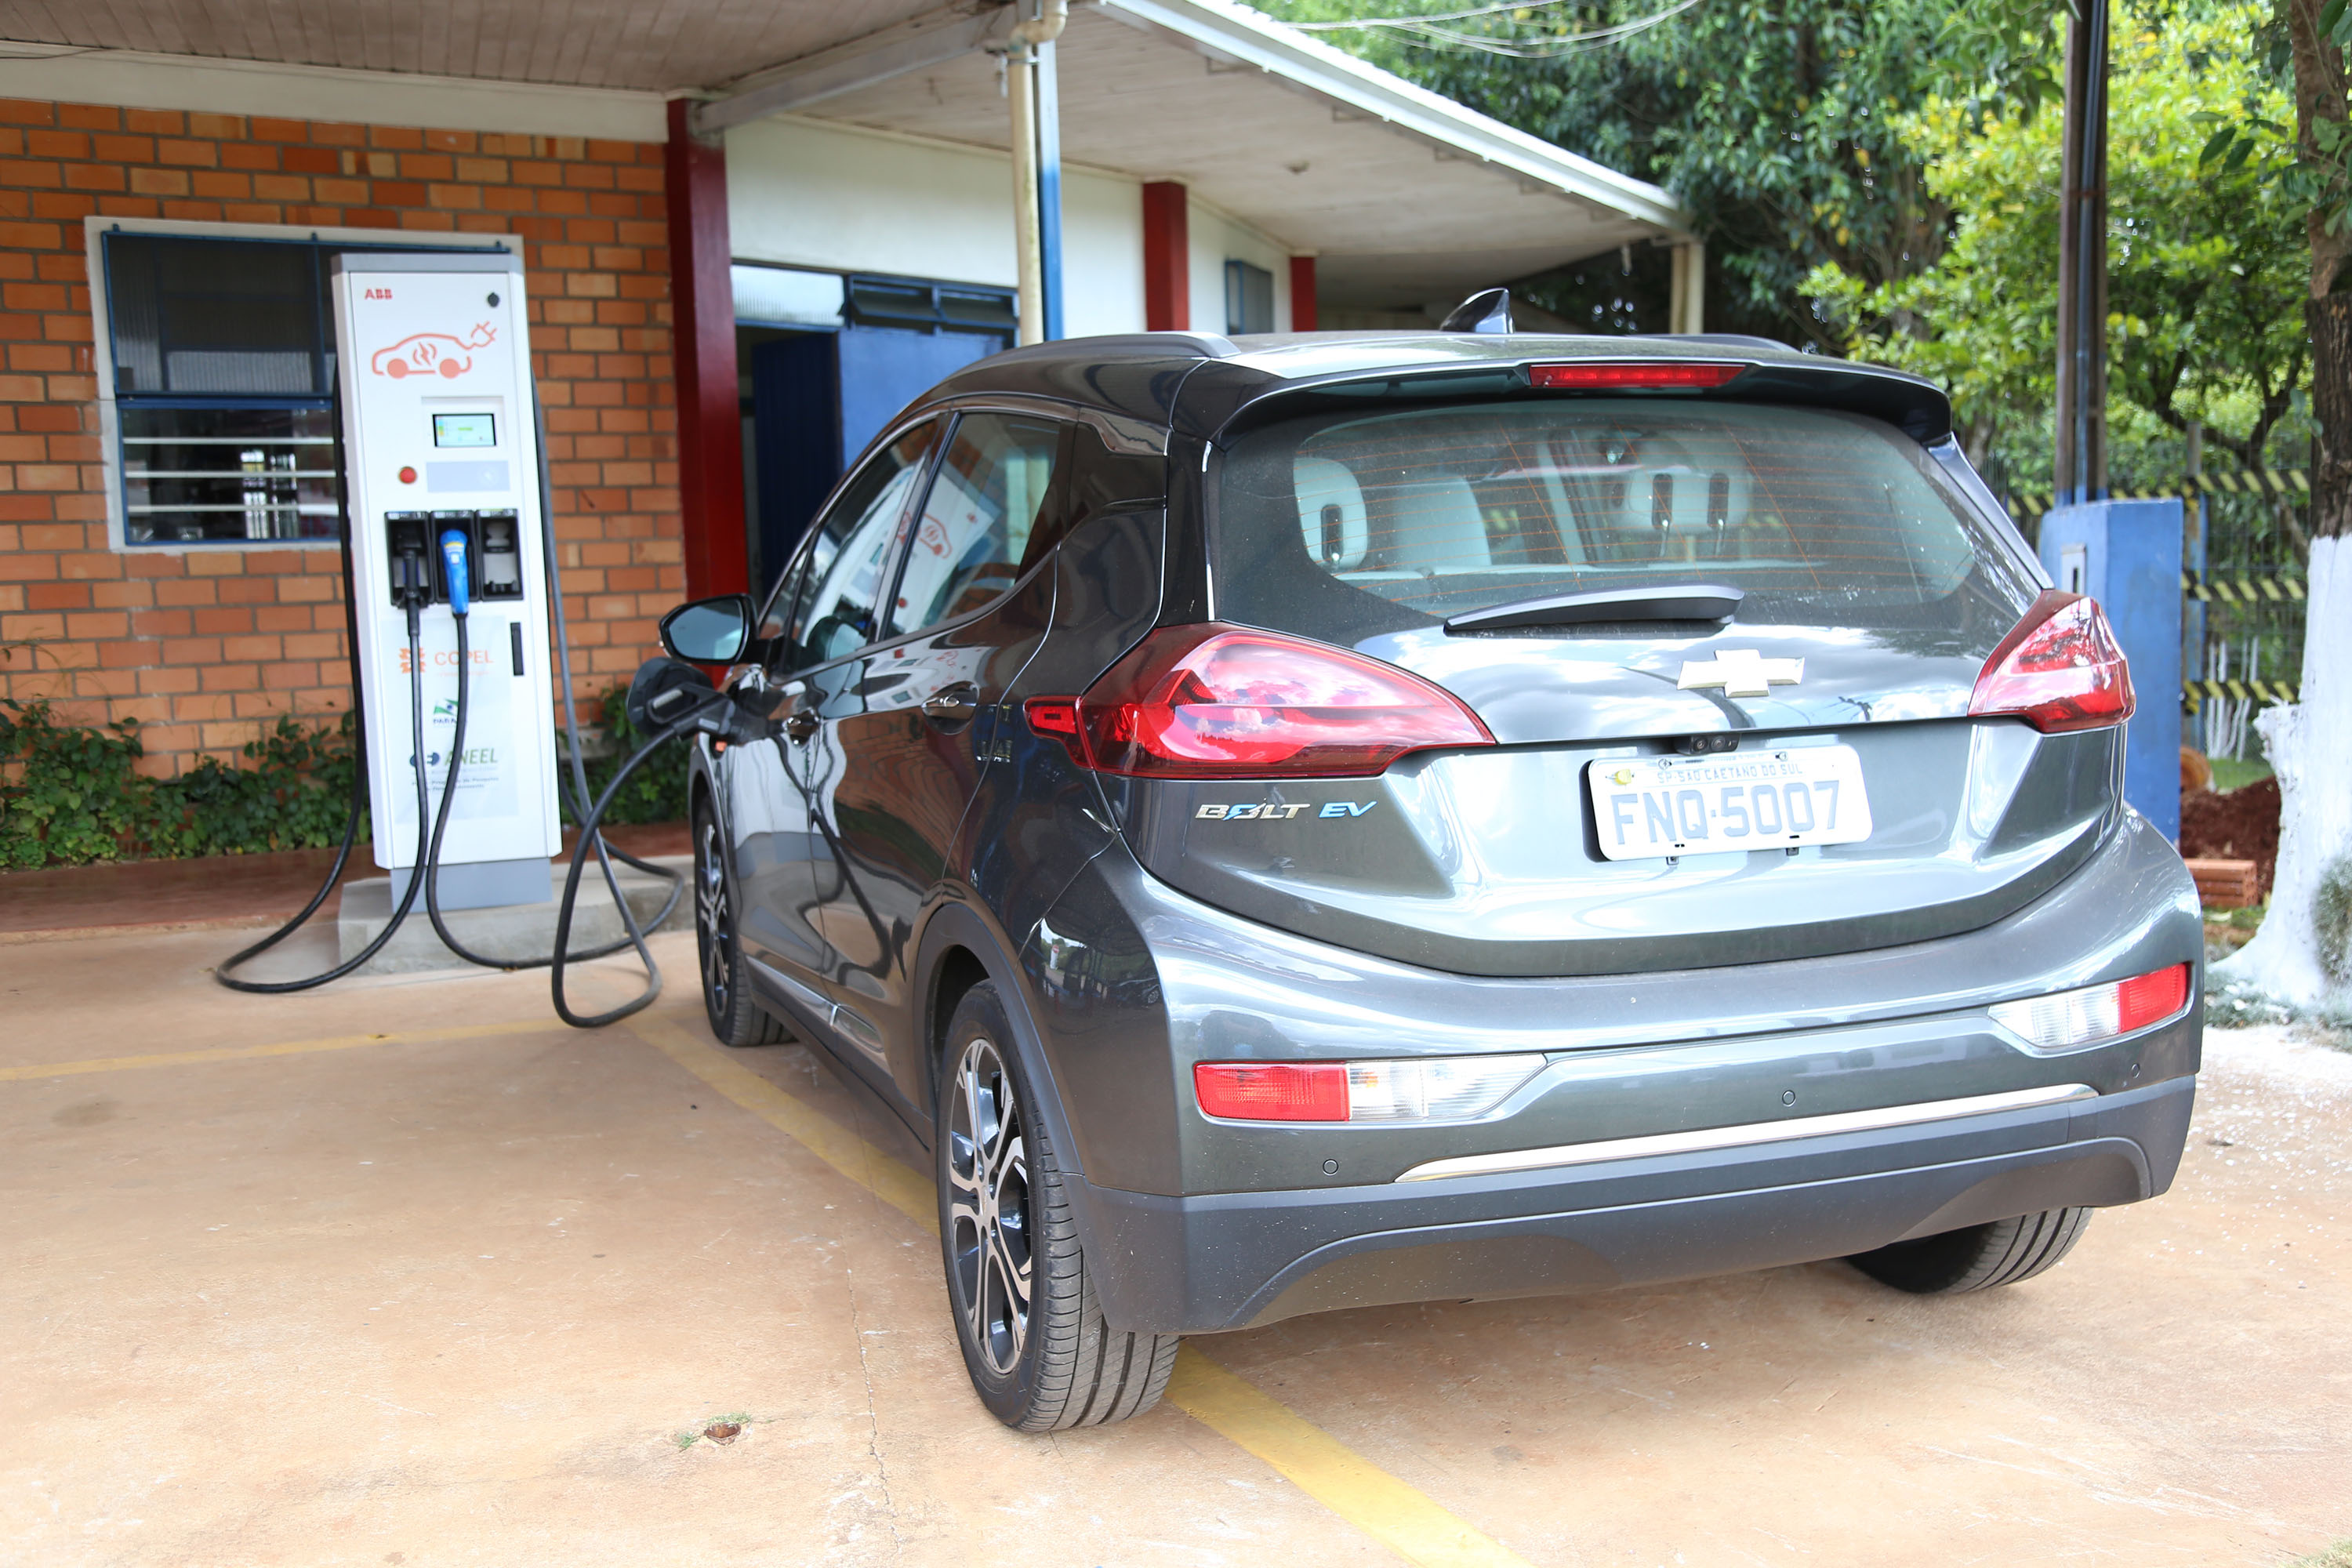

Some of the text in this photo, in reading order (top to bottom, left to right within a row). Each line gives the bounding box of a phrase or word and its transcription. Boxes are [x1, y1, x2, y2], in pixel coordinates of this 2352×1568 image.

[365, 289, 393, 300] ABB
[1704, 765, 1758, 781] CAETANO
[1762, 764, 1777, 777] DO
[1780, 763, 1803, 775] SUL
[1195, 798, 1377, 821] BOLT EV
